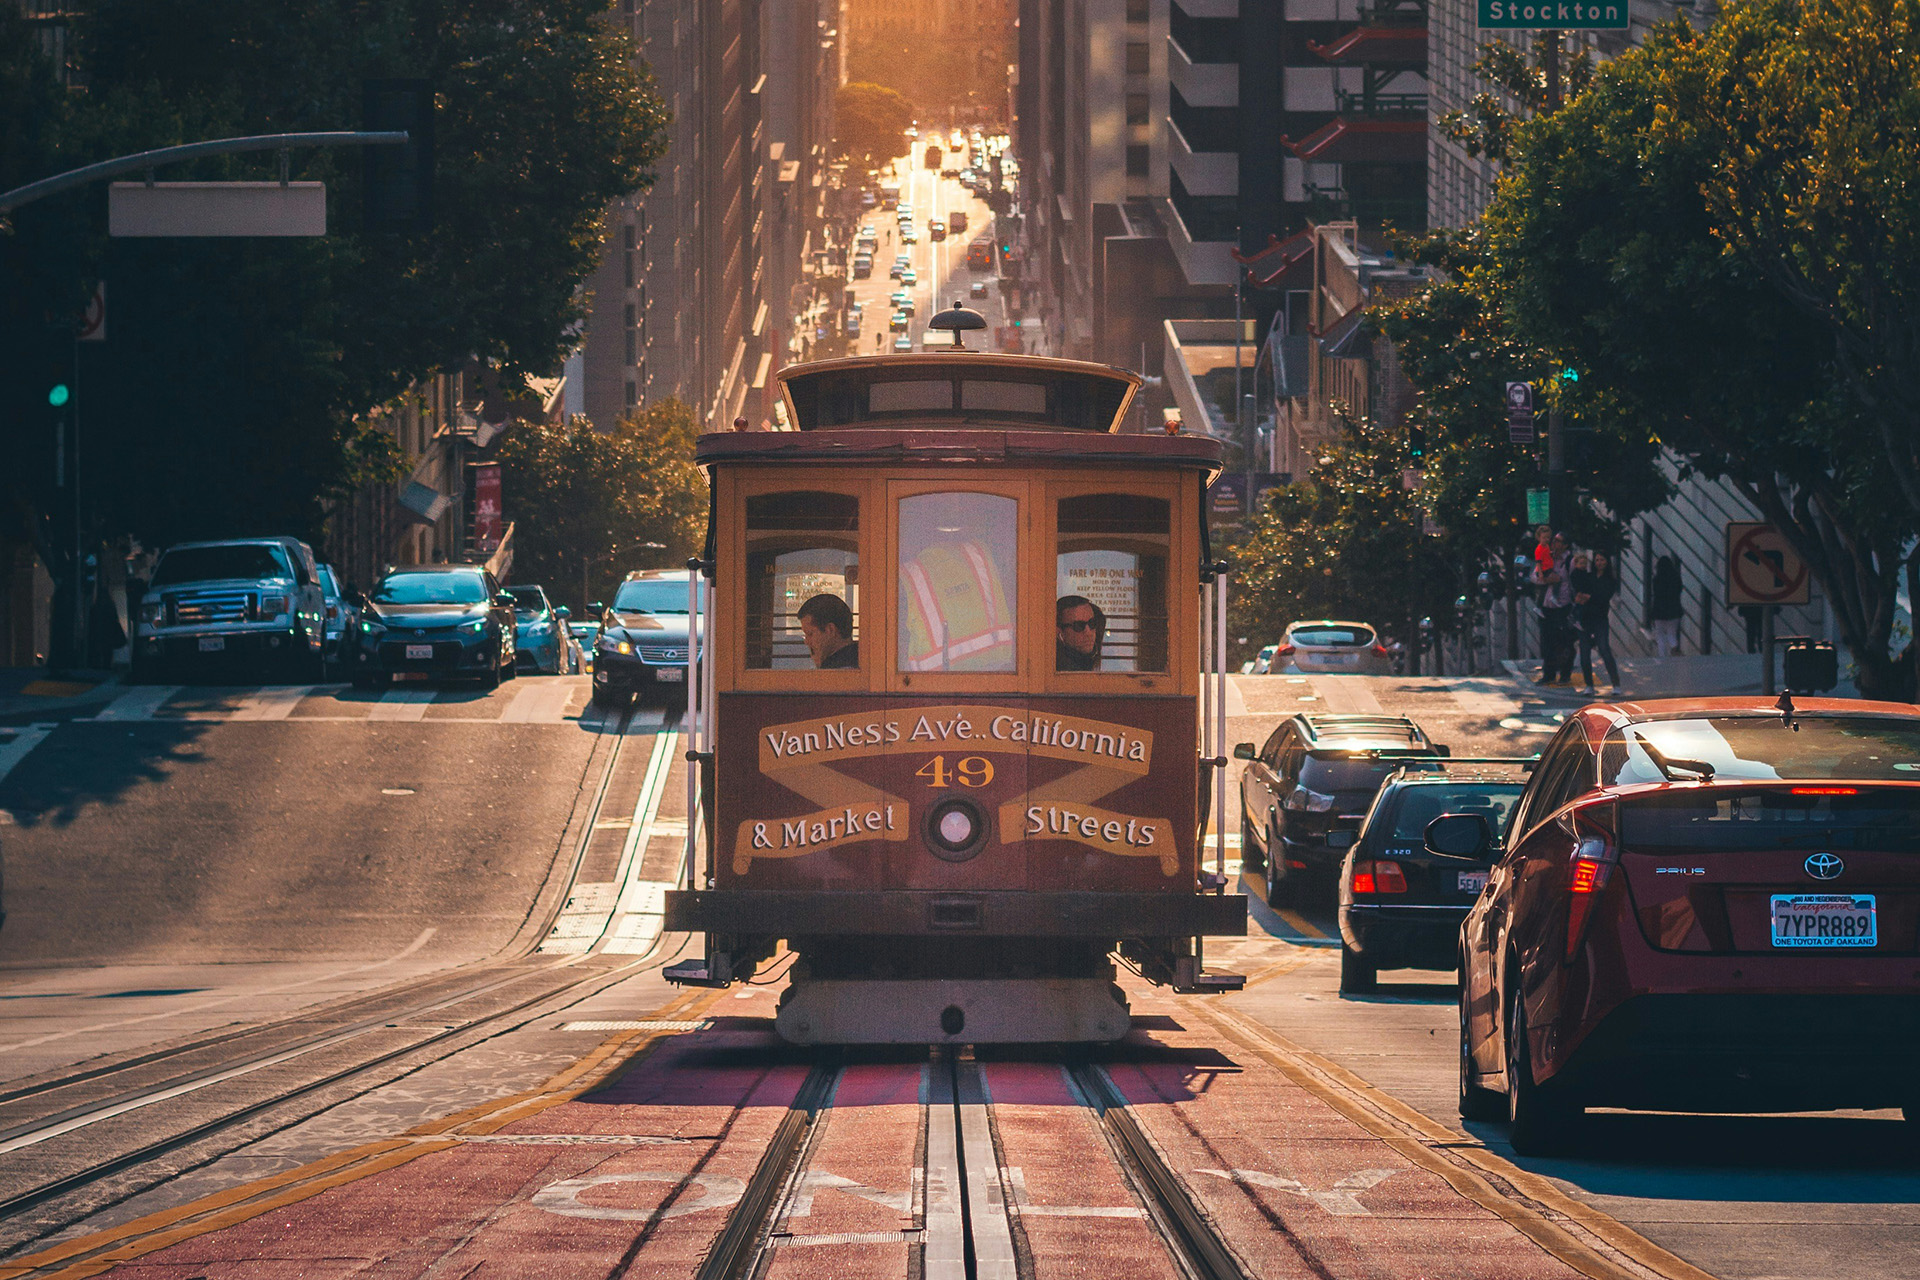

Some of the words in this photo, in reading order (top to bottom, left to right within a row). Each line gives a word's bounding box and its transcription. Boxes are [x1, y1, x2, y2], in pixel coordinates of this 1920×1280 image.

[1489, 1, 1618, 20] Stockton
[1069, 568, 1087, 578] FARE
[1109, 568, 1125, 578] ONE
[766, 730, 821, 757] Van
[824, 721, 901, 750] Ness
[991, 715, 1146, 762] California
[914, 754, 995, 788] 49
[752, 822, 774, 848] &
[782, 805, 895, 848] Market
[1026, 805, 1157, 845] Streets
[1655, 867, 1706, 876] PRIUS
[1793, 903, 1856, 914] California
[1778, 914, 1869, 937] 7YPR889
[1774, 938, 1792, 946] ONE
[1793, 938, 1823, 946] TOYOTA
[1824, 938, 1835, 946] OF
[1836, 938, 1875, 946] OAKLAND
